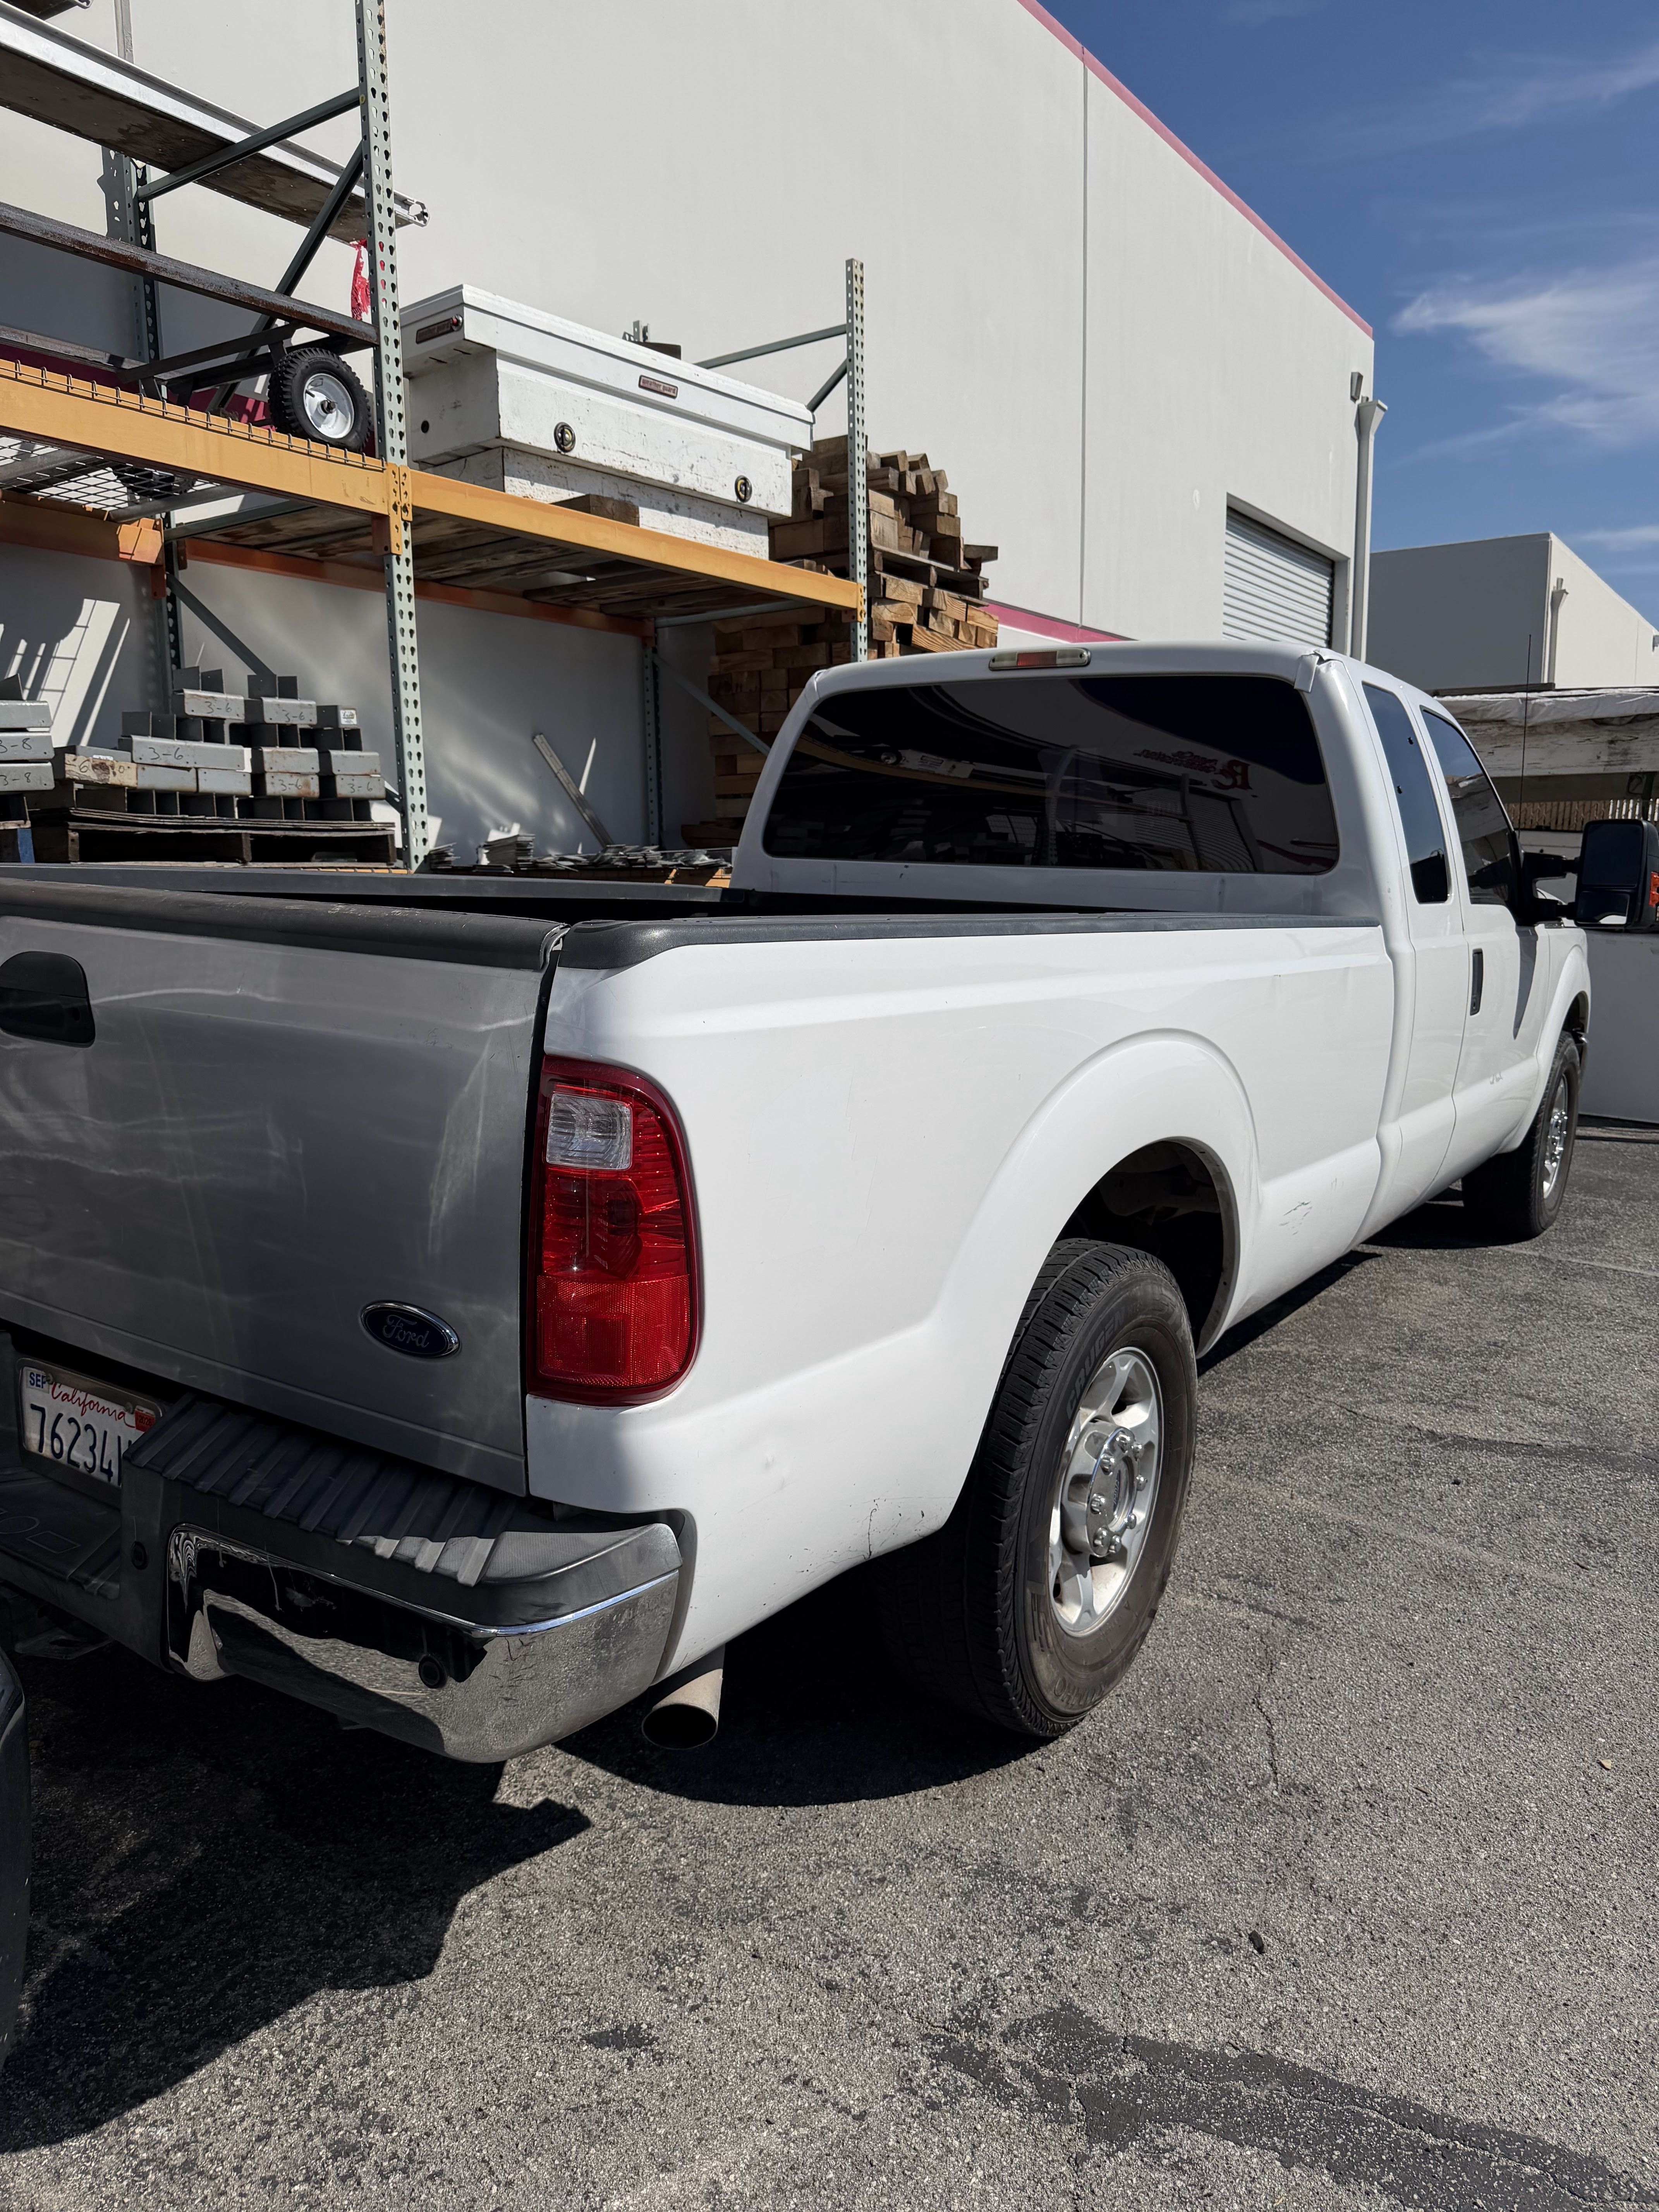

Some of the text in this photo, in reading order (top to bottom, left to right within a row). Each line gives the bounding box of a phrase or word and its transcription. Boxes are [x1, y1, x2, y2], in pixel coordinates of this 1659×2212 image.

[204, 701, 233, 714] 3-6
[148, 747, 184, 760] 3-6
[382, 1314, 429, 1348] Ford
[1066, 1309, 1126, 1420] CRUGEN
[51, 1382, 136, 1429] California
